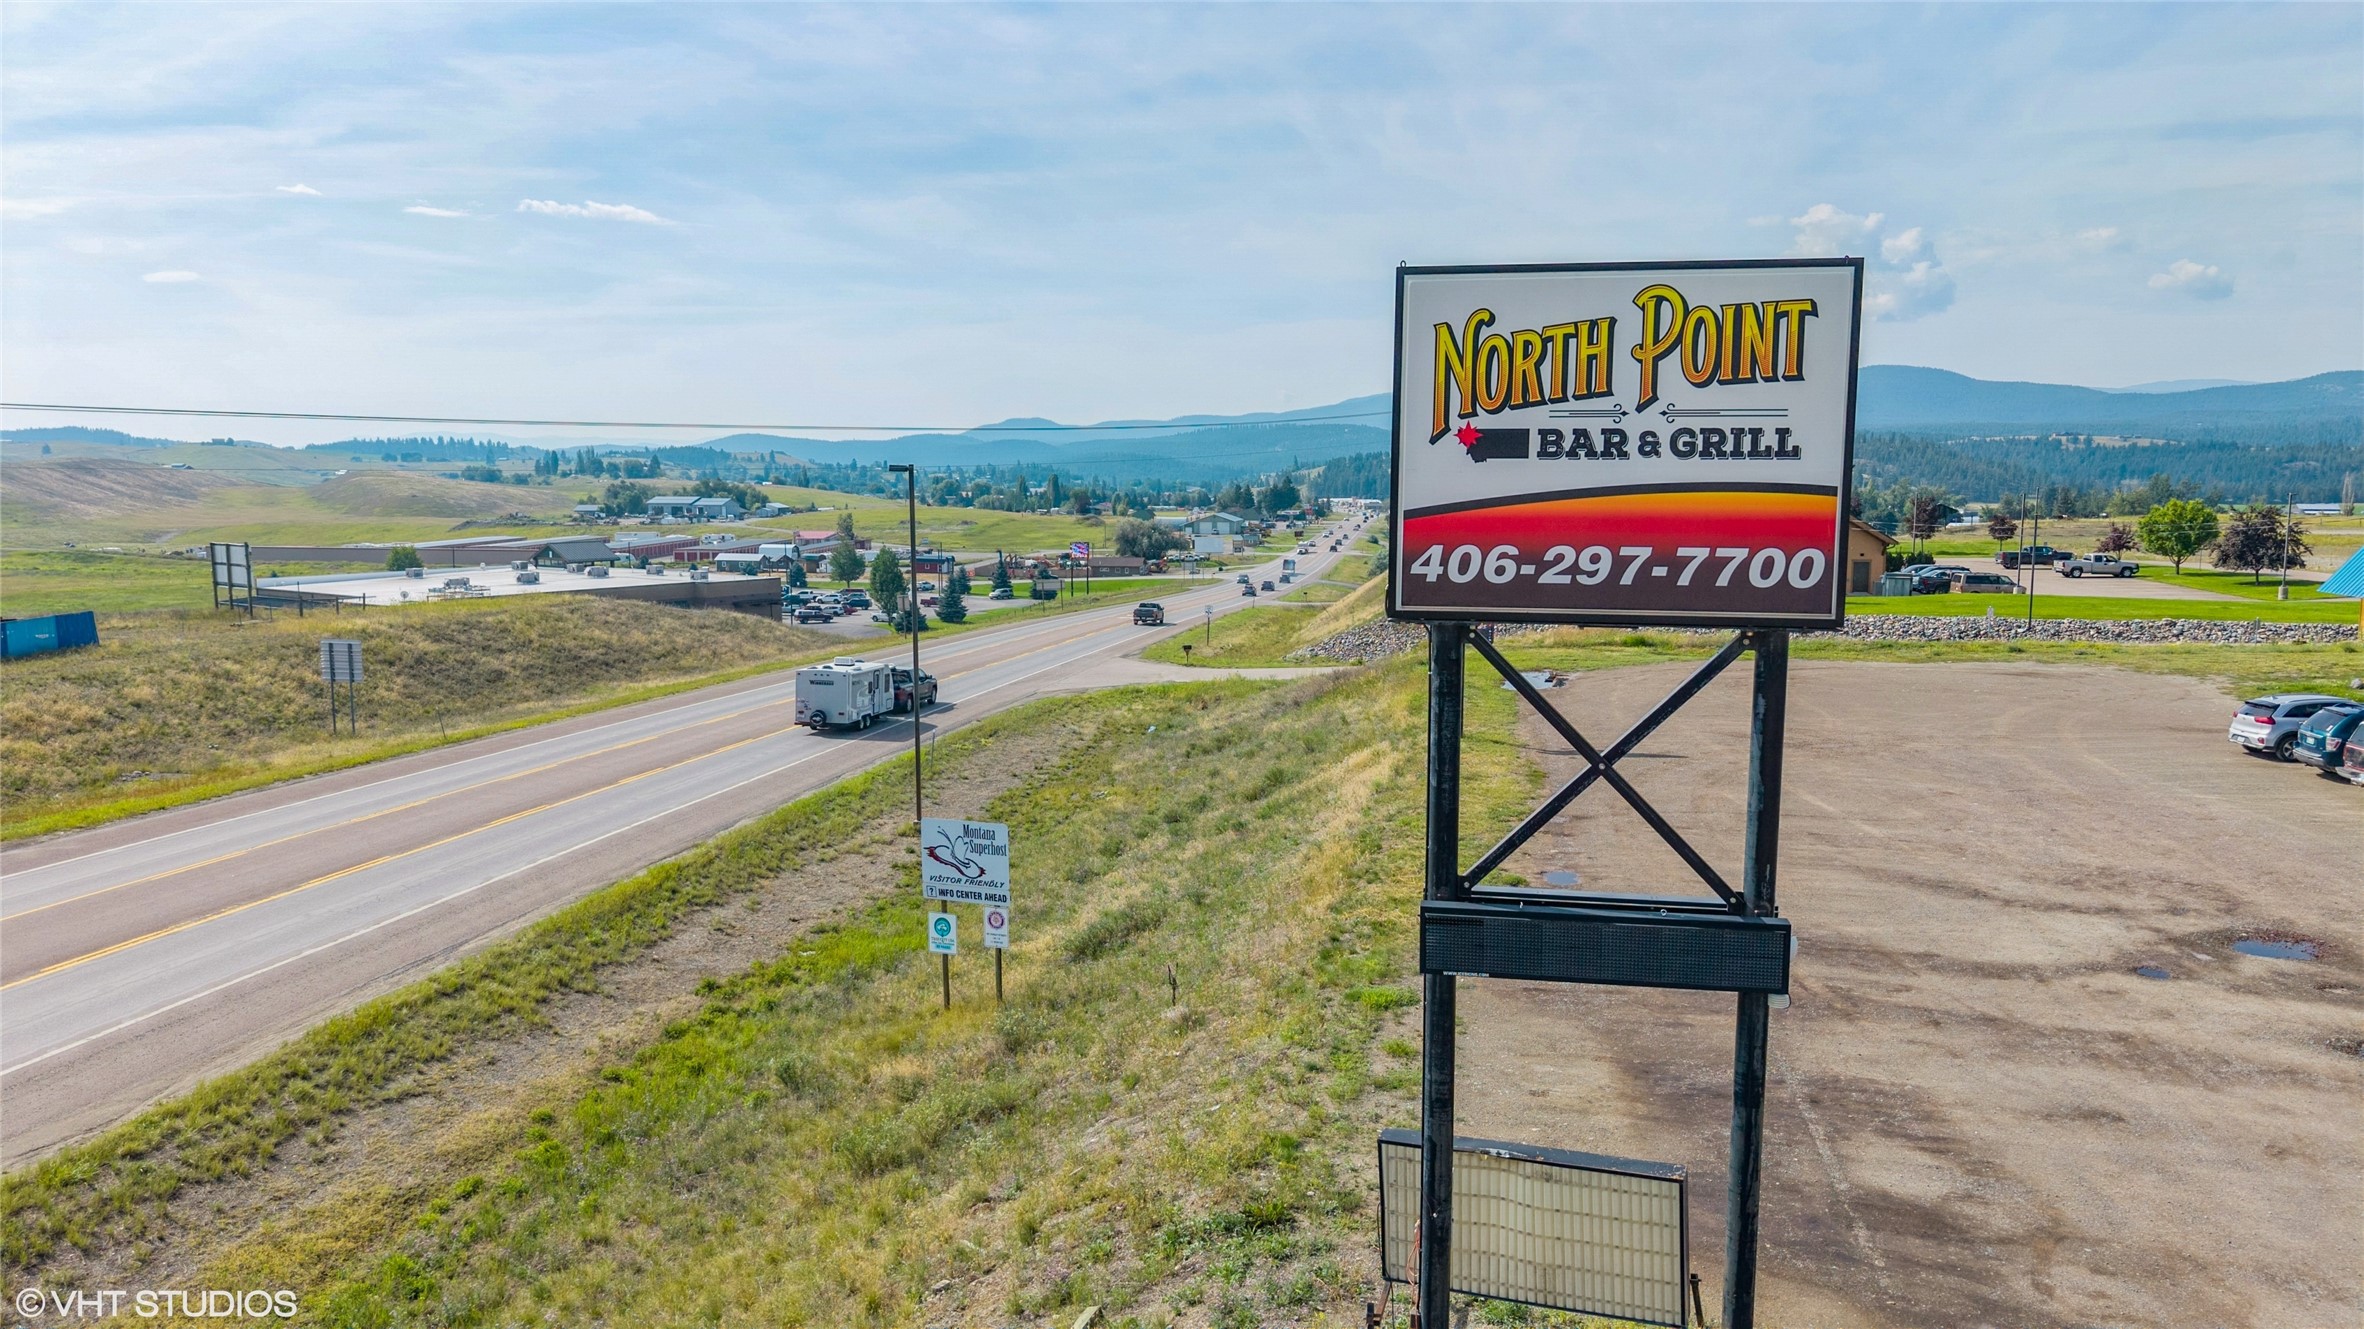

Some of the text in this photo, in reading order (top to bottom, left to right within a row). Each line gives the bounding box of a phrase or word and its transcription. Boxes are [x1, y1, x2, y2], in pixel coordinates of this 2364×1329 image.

[1429, 283, 1819, 445] NORTH POINT
[1536, 427, 1801, 461] BAR & GRILL
[1409, 544, 1827, 589] 406-297-7700
[963, 824, 996, 841] Montana
[969, 839, 1007, 857] Superhost
[929, 875, 1005, 889] VISITOR FRIENDLY
[938, 888, 954, 898] INFO
[956, 890, 982, 900] CENTER
[984, 892, 1008, 903] AHEAD
